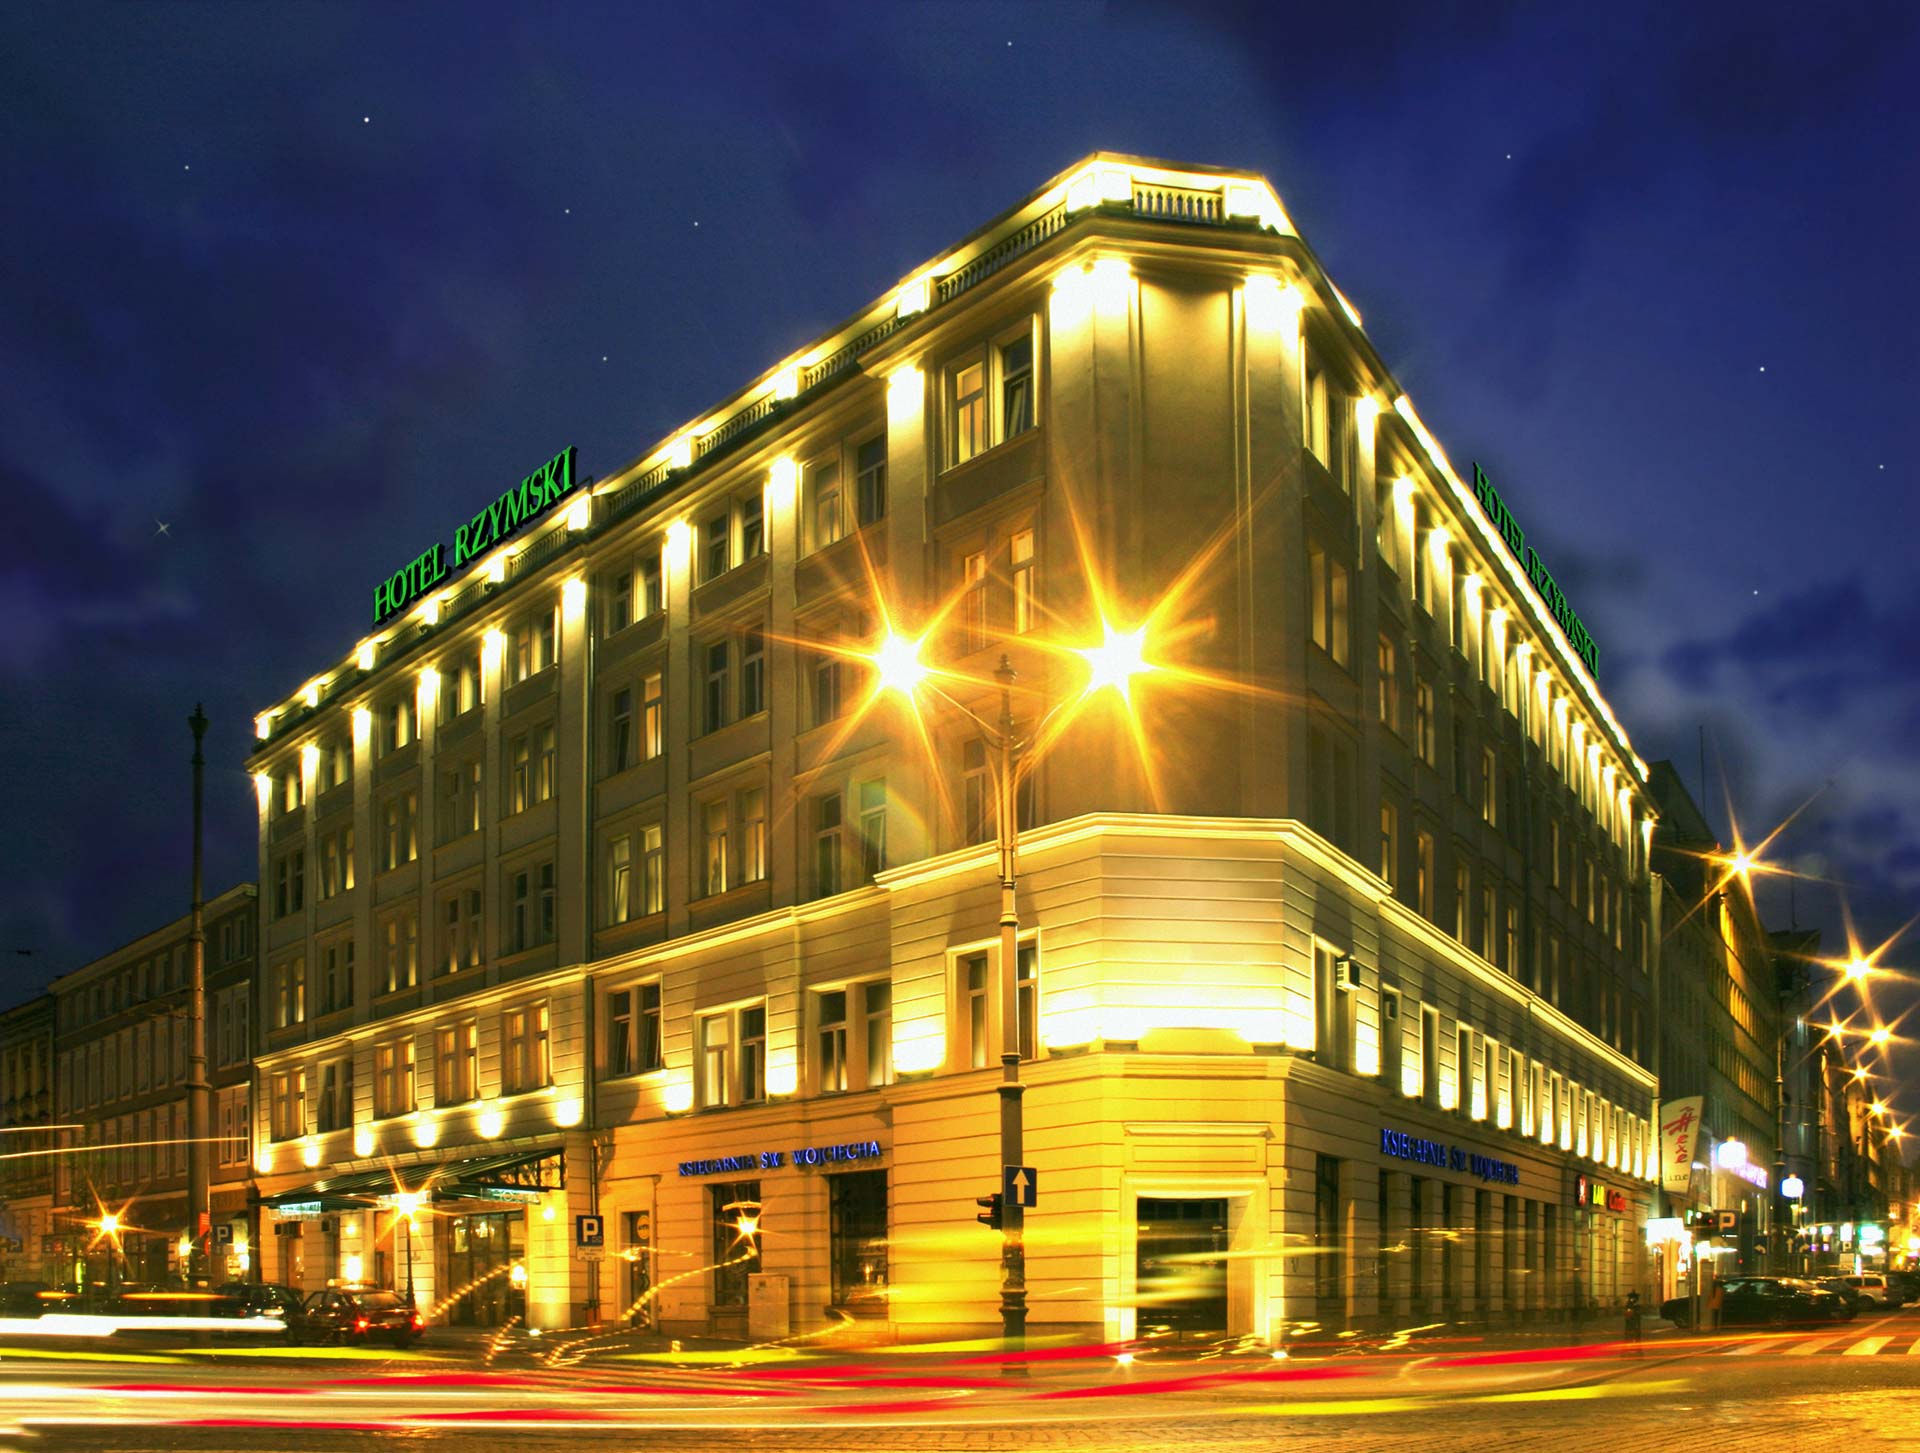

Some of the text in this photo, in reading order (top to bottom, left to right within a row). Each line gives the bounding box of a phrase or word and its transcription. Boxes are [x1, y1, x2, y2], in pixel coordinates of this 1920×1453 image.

[373, 445, 575, 624] HOTEL RZYMSKI
[1473, 462, 1601, 680] HOTEL RZYMSKI
[792, 1140, 880, 1166] WOJCIECHA
[217, 1226, 228, 1242] P
[583, 1218, 599, 1242] P
[1719, 1212, 1736, 1232] P
